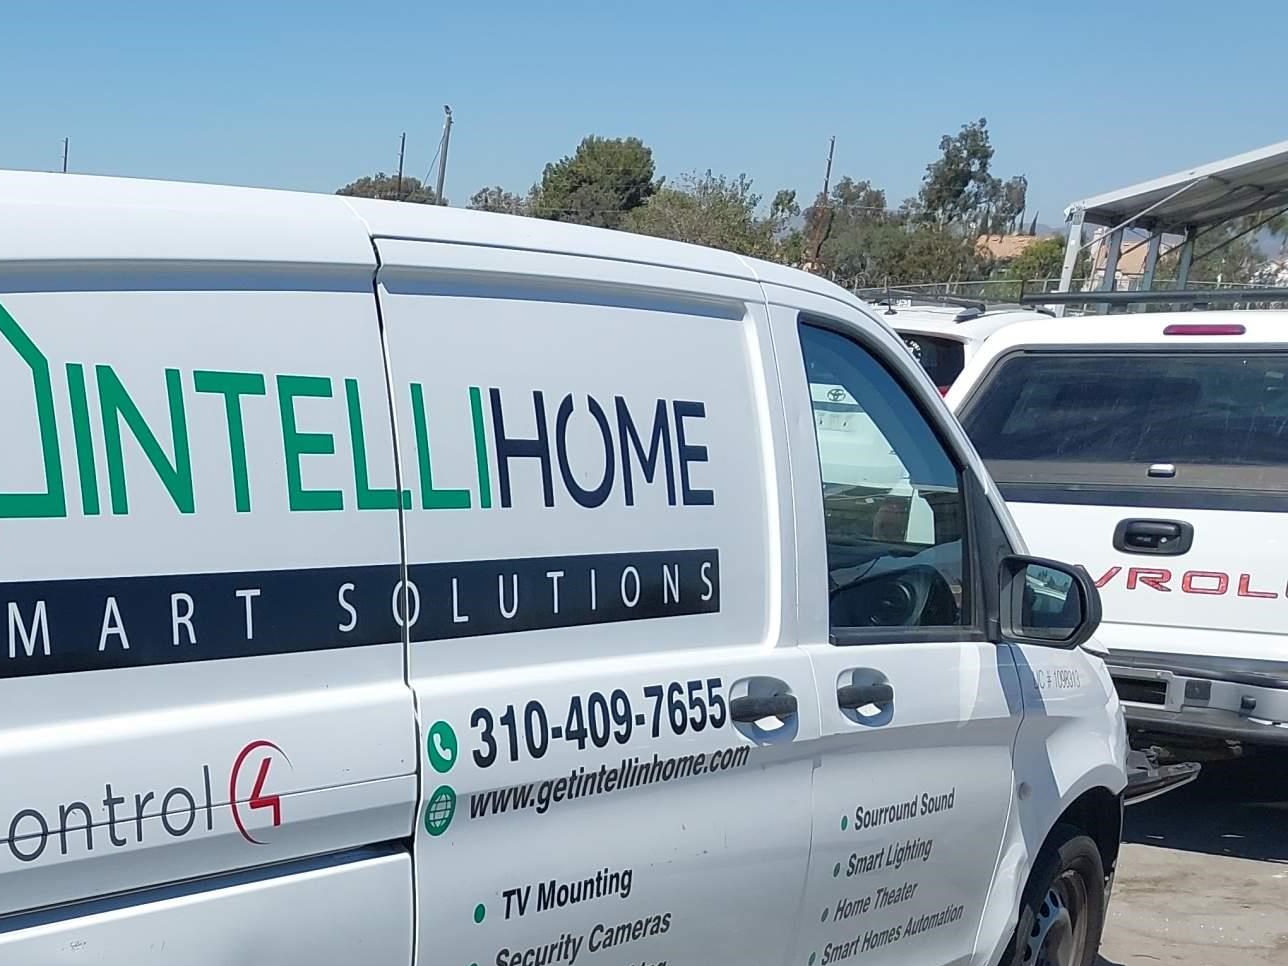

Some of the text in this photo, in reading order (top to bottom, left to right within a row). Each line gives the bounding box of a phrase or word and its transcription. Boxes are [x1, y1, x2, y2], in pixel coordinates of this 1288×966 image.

[66, 362, 715, 516] INTELLIHOME
[337, 559, 716, 633] SOLUTIONS
[470, 676, 727, 769] 310-409-7655
[469, 742, 751, 820] www.getintellinhome.com
[854, 787, 955, 831] Sourround Sound
[846, 838, 933, 877] Smart Lighting
[502, 865, 633, 920] TV Mounting
[833, 881, 918, 922] Home Theater
[588, 909, 672, 955] Cameras
[821, 904, 964, 966] Smart Homes Automation
